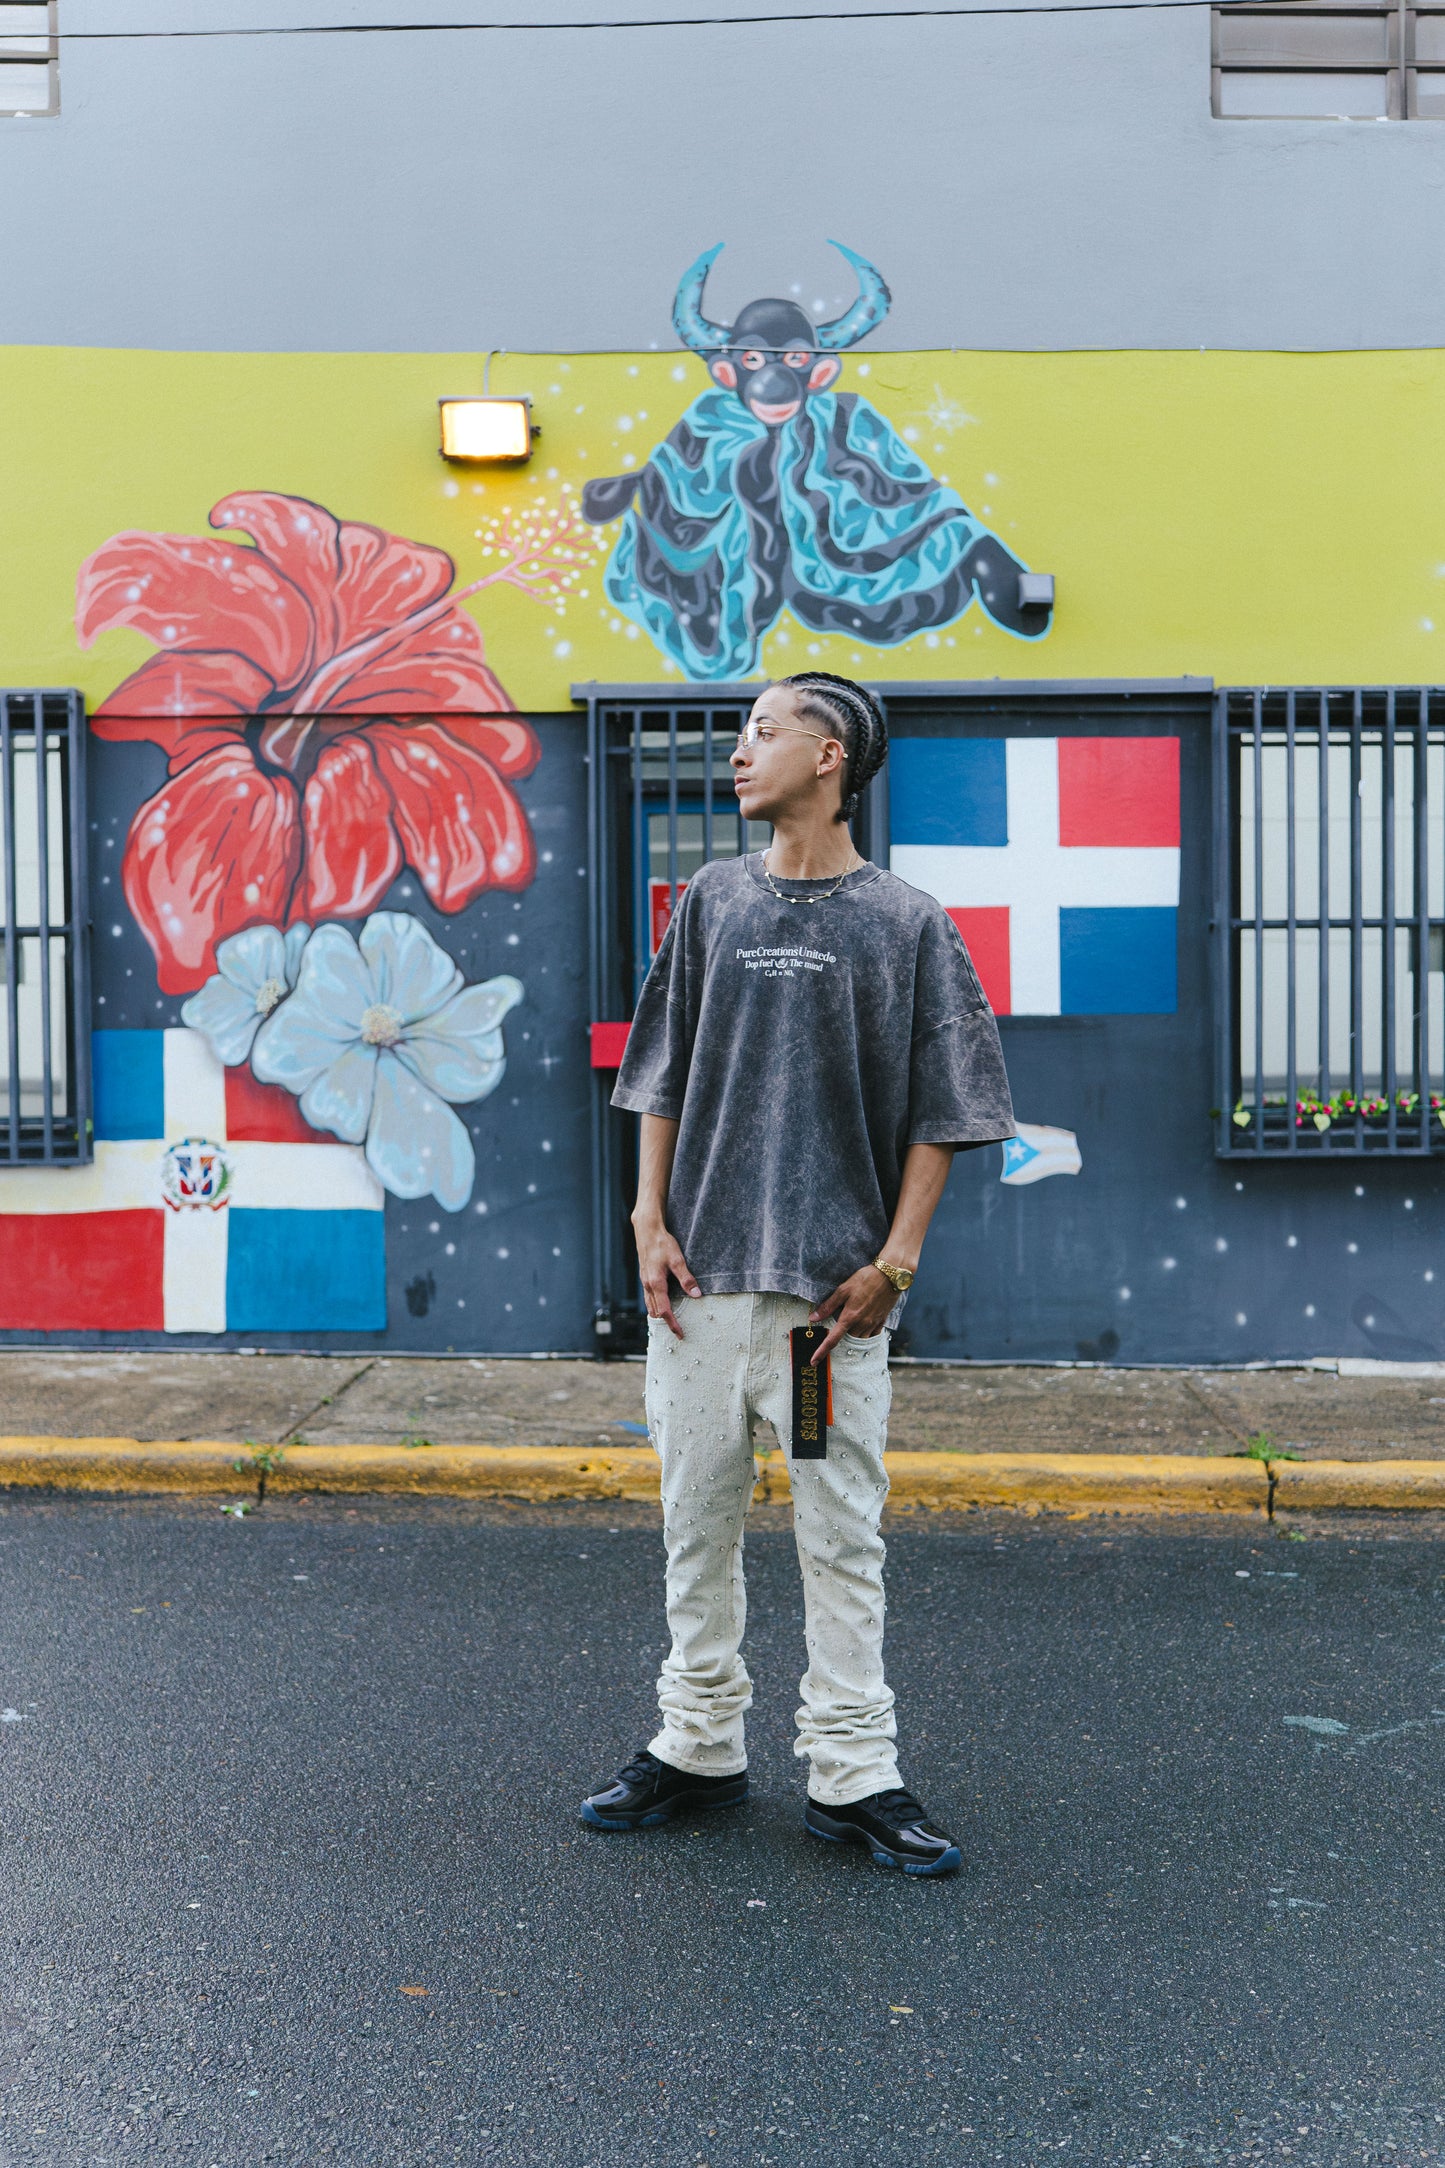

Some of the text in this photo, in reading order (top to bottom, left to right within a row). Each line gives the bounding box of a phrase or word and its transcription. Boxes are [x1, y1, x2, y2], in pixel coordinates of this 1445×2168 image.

[789, 959, 804, 967] The
[804, 963, 824, 971] mind
[801, 1365, 818, 1441] VICIOUS
